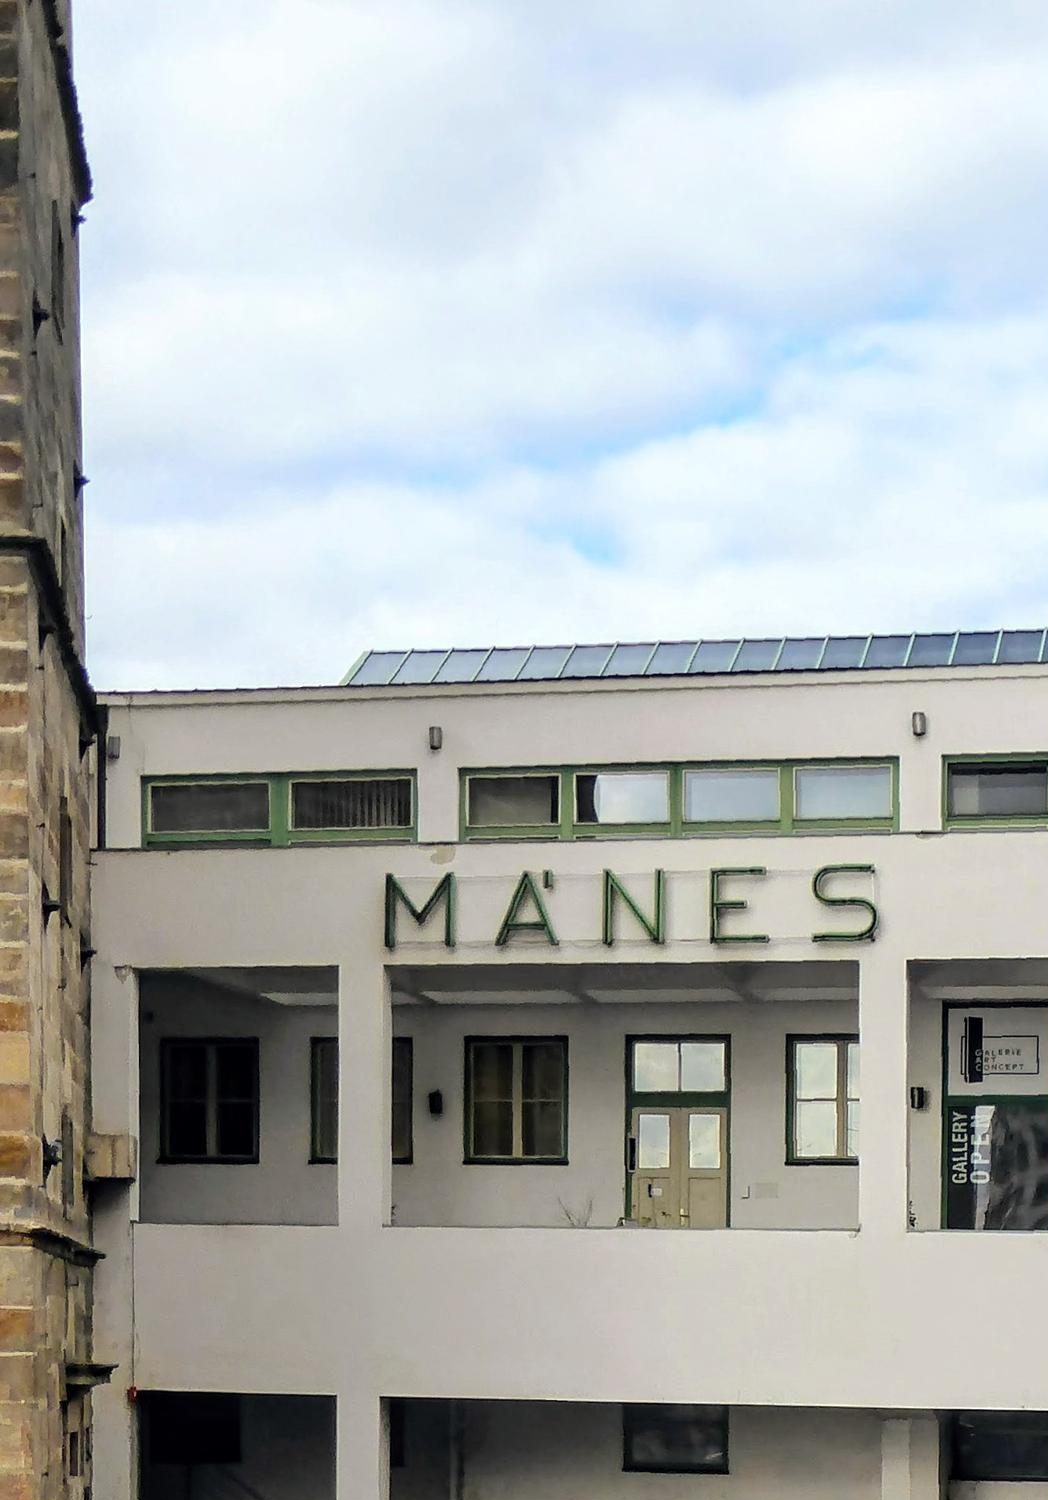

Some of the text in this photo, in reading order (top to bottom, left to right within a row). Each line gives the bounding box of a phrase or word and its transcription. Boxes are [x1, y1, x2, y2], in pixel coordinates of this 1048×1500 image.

[384, 864, 879, 948] MÁNES
[975, 1049, 1022, 1057] GALERIE
[975, 1064, 1025, 1072] CONCEPT
[952, 1111, 969, 1184] GALLERY
